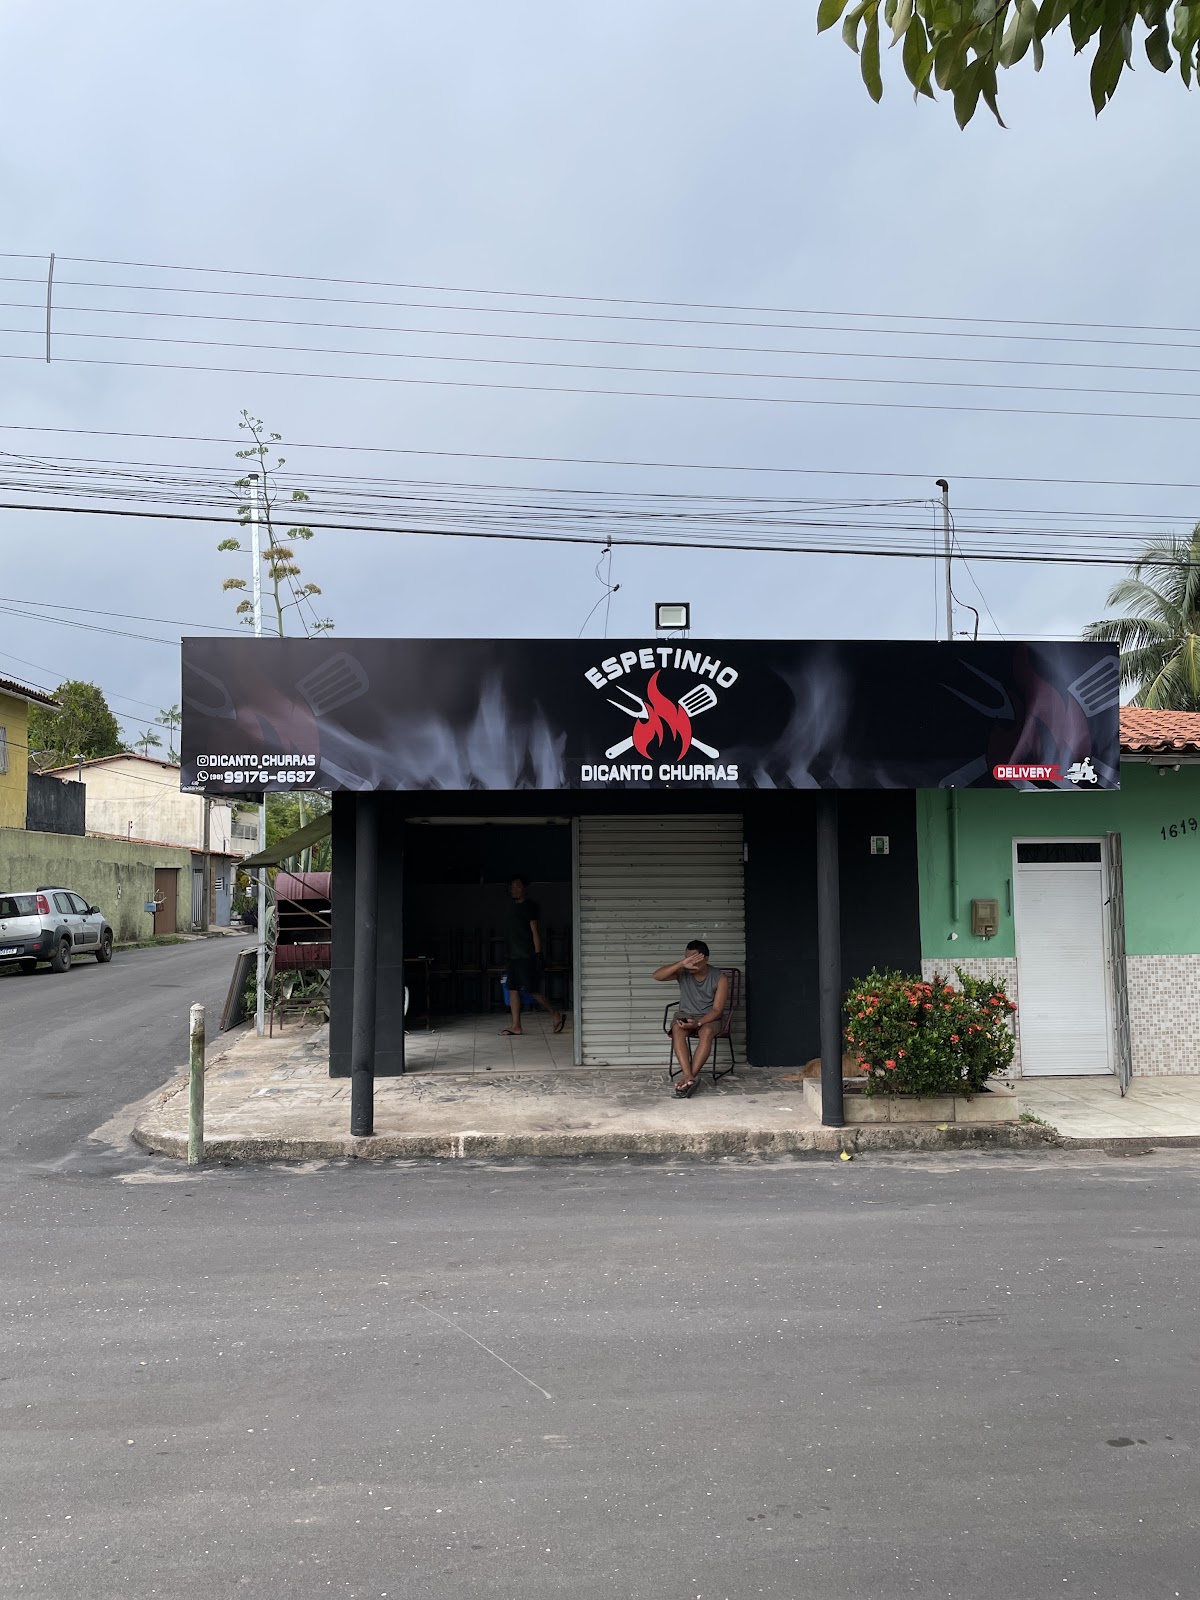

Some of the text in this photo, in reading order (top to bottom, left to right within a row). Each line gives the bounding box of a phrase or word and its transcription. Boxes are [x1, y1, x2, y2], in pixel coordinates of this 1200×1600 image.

[584, 647, 739, 690] ESPETINHO
[209, 754, 316, 769] DICANTO_CHURRAS
[224, 770, 316, 783] 99176-6637
[581, 764, 739, 782] DICANTO CHURRAS
[997, 767, 1052, 779] DELIVERY
